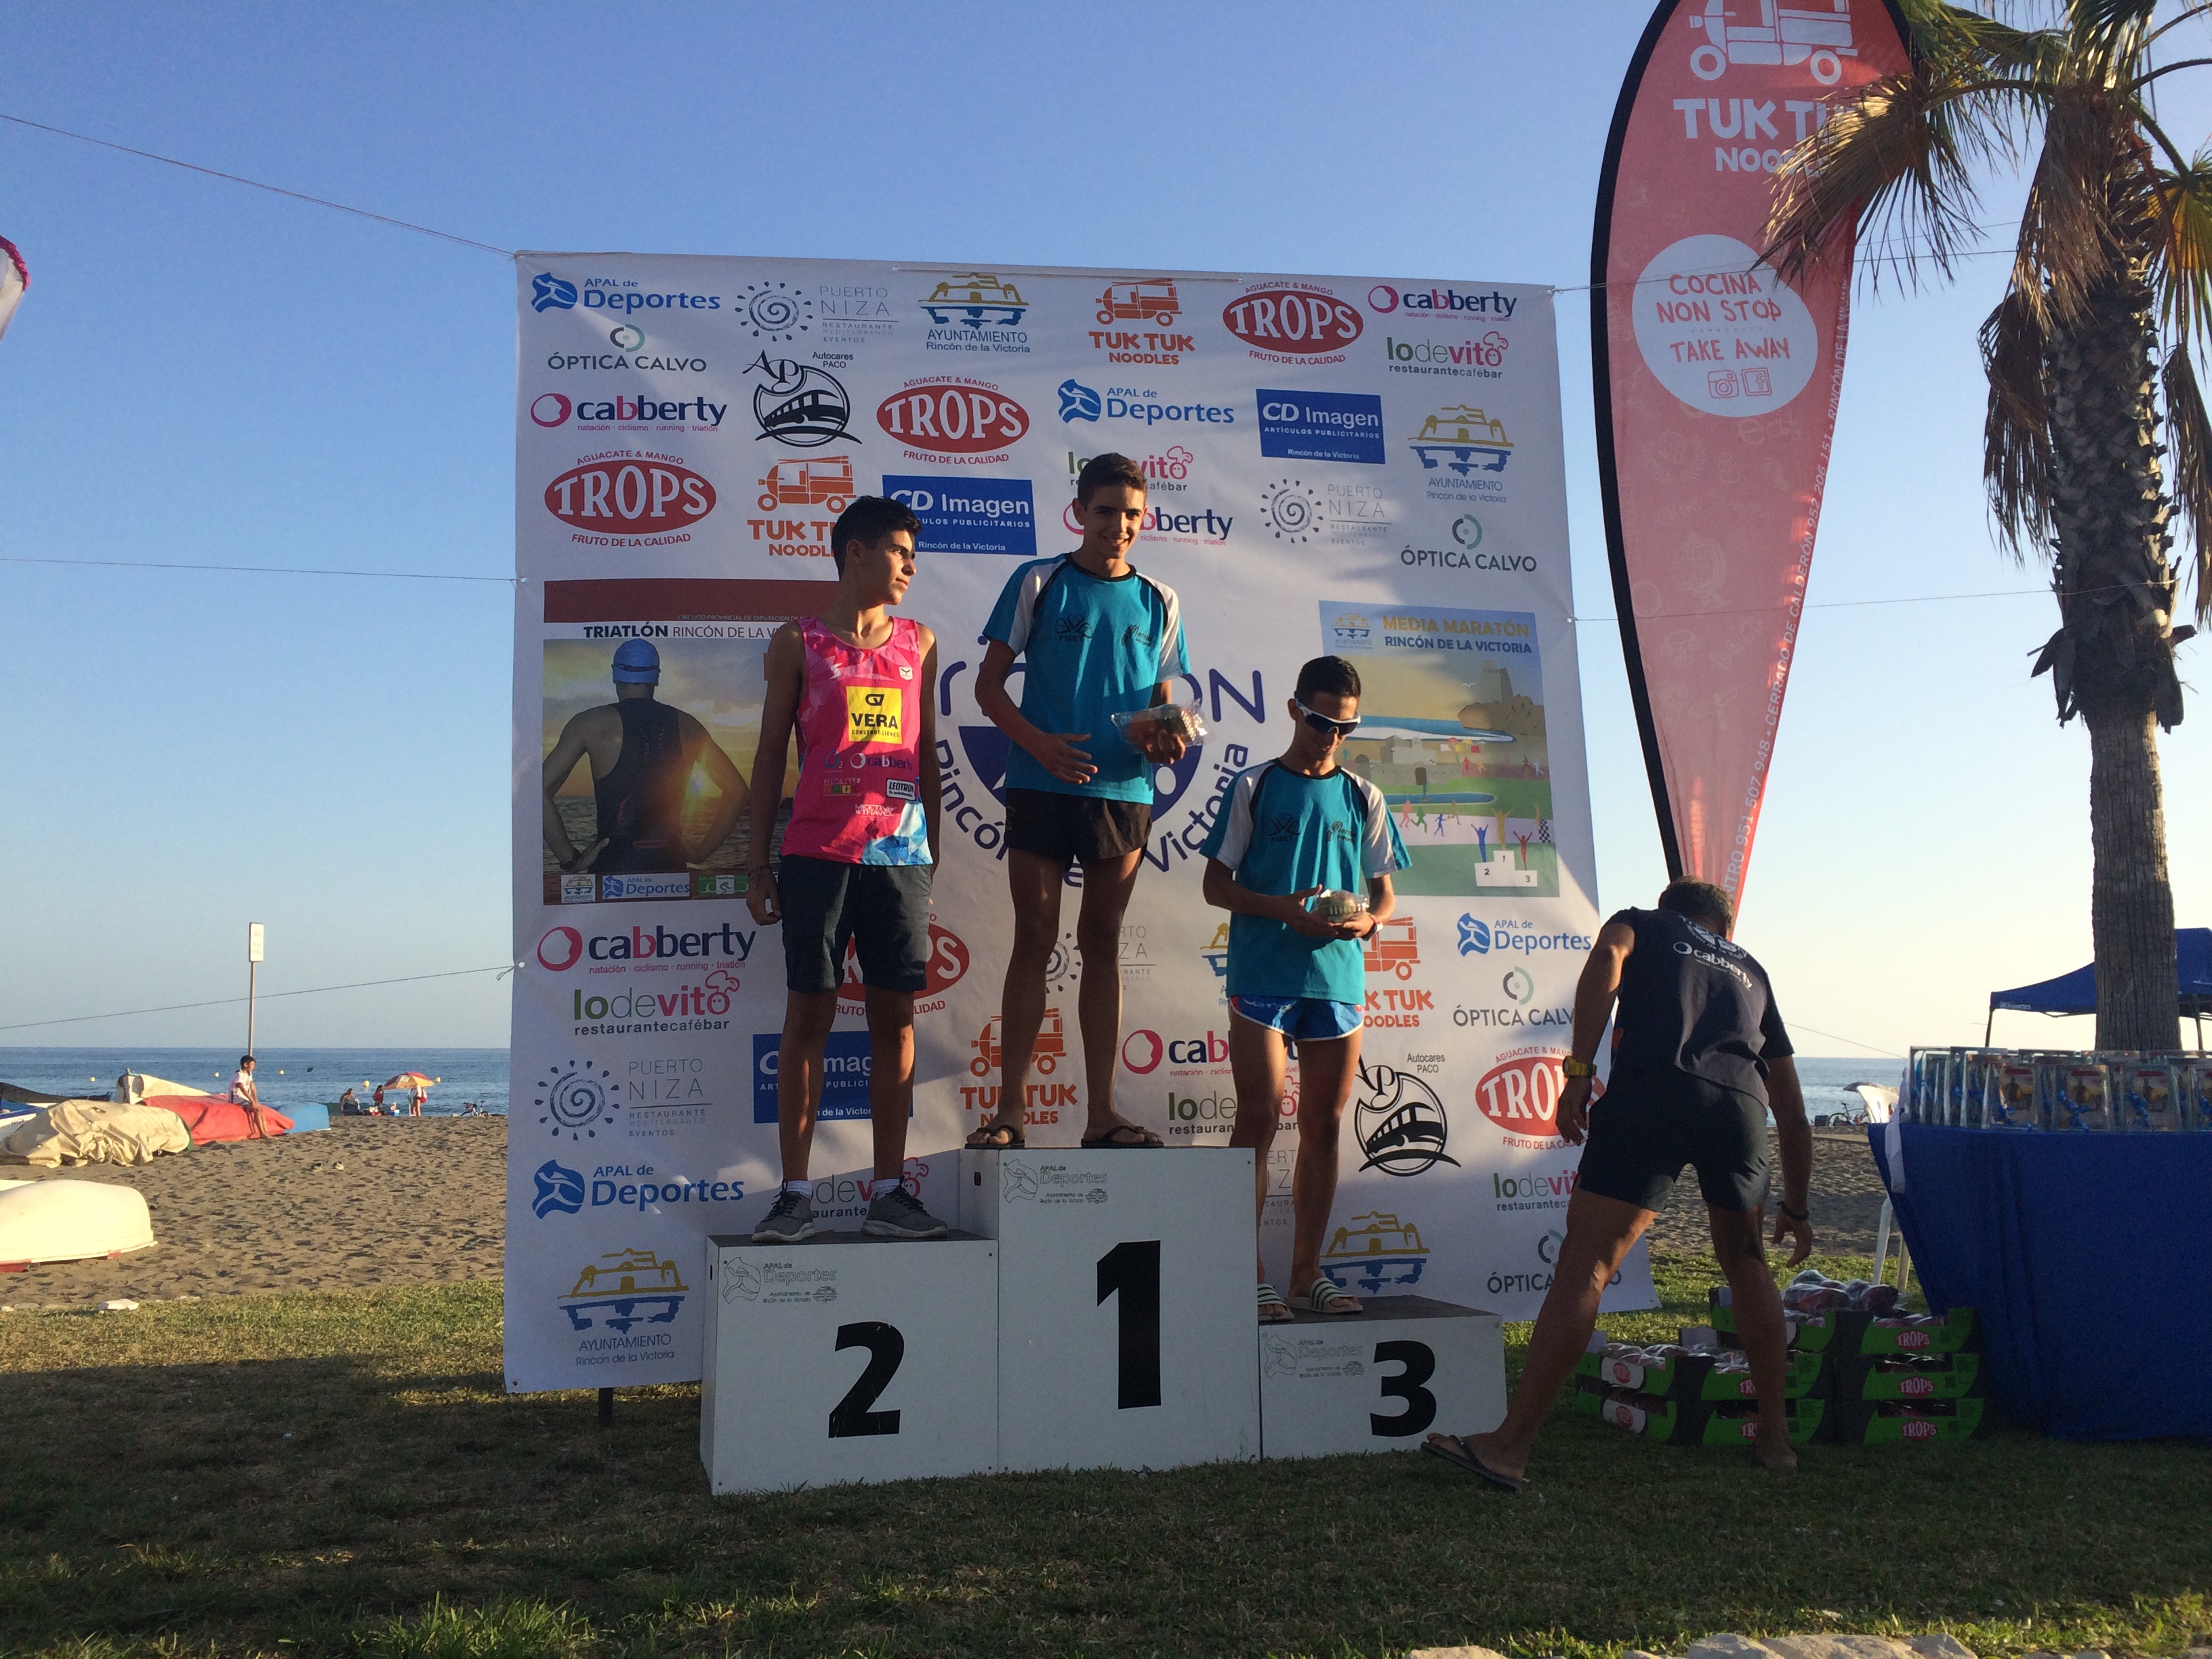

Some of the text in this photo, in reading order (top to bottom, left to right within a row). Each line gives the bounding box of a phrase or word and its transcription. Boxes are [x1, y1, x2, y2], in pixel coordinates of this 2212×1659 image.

[1673, 98, 1779, 140] TUK
[584, 279, 619, 287] APAL
[1245, 281, 1334, 295] AGUACATE MANGO
[1668, 272, 1762, 295] COCINA
[819, 286, 888, 298] PUERTO
[583, 289, 720, 314] Deportes
[821, 300, 890, 316] NIZA
[1403, 289, 1517, 317] cabberty
[1230, 295, 1357, 340] TROPS
[1656, 296, 1782, 324] NON STOP
[822, 322, 893, 330] RESTAURANTE
[1837, 325, 1849, 339] LA
[928, 329, 1027, 343] AYUNTAMIENTO
[1088, 331, 1195, 352] TUK TUK
[926, 342, 1030, 353] Rincón de la Victoria
[1387, 337, 1502, 367] lodevito
[1669, 337, 1791, 363] TAKE AWAY
[1835, 344, 1847, 360] DE
[548, 351, 707, 372] ÓPTICA CALVO
[813, 351, 854, 361] Autocares
[1109, 352, 1179, 365] NOODLES
[1249, 350, 1346, 365] FRUTO DE LA CALIDAD
[823, 361, 846, 369] PACO
[1389, 365, 1502, 378] restaurantecafébar
[903, 376, 952, 388] AGUACATE
[964, 377, 999, 391] MANGO
[1107, 388, 1158, 398] APAL de
[1828, 365, 1843, 421] RINCÓN
[577, 394, 728, 427] cabberty
[884, 390, 1022, 440] TROPS
[1107, 398, 1235, 426] Deportes
[1263, 403, 1379, 429] CD Imagen
[656, 424, 684, 432] running
[1264, 426, 1380, 439] ARTÍCULOS PUBLICITARIOS
[577, 450, 632, 466] AGUACATE
[645, 451, 684, 465] MANGO
[903, 450, 937, 462] FRUTO
[939, 455, 951, 464] DE
[968, 453, 1009, 464] CALIDAD
[1288, 449, 1359, 459] Rincón Victoria
[1328, 484, 1382, 499] PUERTO
[1429, 477, 1503, 491] AYUNTAMIENTO
[554, 465, 708, 520] TROPS
[1457, 493, 1507, 503] de Victoria
[941, 493, 1029, 518] Imagen
[1329, 499, 1385, 518] NIZA
[747, 519, 806, 541] TUK
[953, 519, 1030, 528] PUBLICITARIOS
[571, 533, 691, 547] FRUTO DE LA CALIDAD
[918, 541, 1006, 551] Rincón de la Victoria
[1173, 536, 1197, 545] running
[769, 544, 834, 557] NOODL
[1400, 545, 1538, 573] ÓPTICA CALVO
[1765, 434, 1832, 726] CERRADO DE CALDERÓN 952 206 151
[583, 621, 668, 638] TRIATLÓN
[673, 625, 723, 638] RINCÓN
[728, 627, 744, 638] DE
[749, 628, 764, 638] LA
[1382, 615, 1530, 638] MEDIA MARATÓN
[1385, 635, 1434, 649] RINCÓN
[1437, 638, 1454, 650] DE
[1457, 640, 1473, 651] LA
[1475, 640, 1532, 654] VICTORIA
[851, 713, 899, 729] VERA
[1736, 739, 1771, 846] 951 507 948
[626, 883, 691, 897] Deportes
[1494, 920, 1533, 928] APAL de
[589, 923, 757, 962] cabberty
[1494, 930, 1592, 956] Deportes
[590, 962, 709, 974] natación ciclismo running
[1694, 949, 1753, 989] cabberty
[574, 985, 731, 1021] lodevito
[1383, 989, 1435, 1010] TUK
[1364, 1015, 1420, 1027] OODLES
[1453, 1004, 1575, 1027] ÓPTICA CALV
[575, 1019, 730, 1036] restaurantecafébar
[1407, 1052, 1446, 1063] Autocares
[1496, 1046, 1539, 1063] AGUACATE
[629, 1059, 703, 1076] PUERTO
[1417, 1064, 1439, 1073] PACO
[630, 1078, 703, 1101] NIZA
[630, 1109, 706, 1119] RESTAURANTE
[822, 1107, 844, 1116] de la
[1502, 1136, 1532, 1149] FRUTO
[1534, 1141, 1544, 1149] DE
[1545, 1141, 1555, 1150] LA
[593, 1164, 654, 1178] APAL de
[1040, 1171, 1107, 1187] Deportes
[591, 1179, 744, 1212] Deportes
[764, 1269, 836, 1286] Deportes
[1097, 1240, 1162, 1410] 1
[579, 1334, 672, 1351] AYUNTAMIENTO
[1897, 1330, 1930, 1348] TROPS
[612, 1350, 674, 1364] de la Victoria
[1299, 1345, 1362, 1361] Deportes
[829, 1322, 905, 1438] 2
[1900, 1376, 1933, 1394] TROPS
[1370, 1340, 1437, 1437] 3
[1902, 1421, 1937, 1437] TROPS
